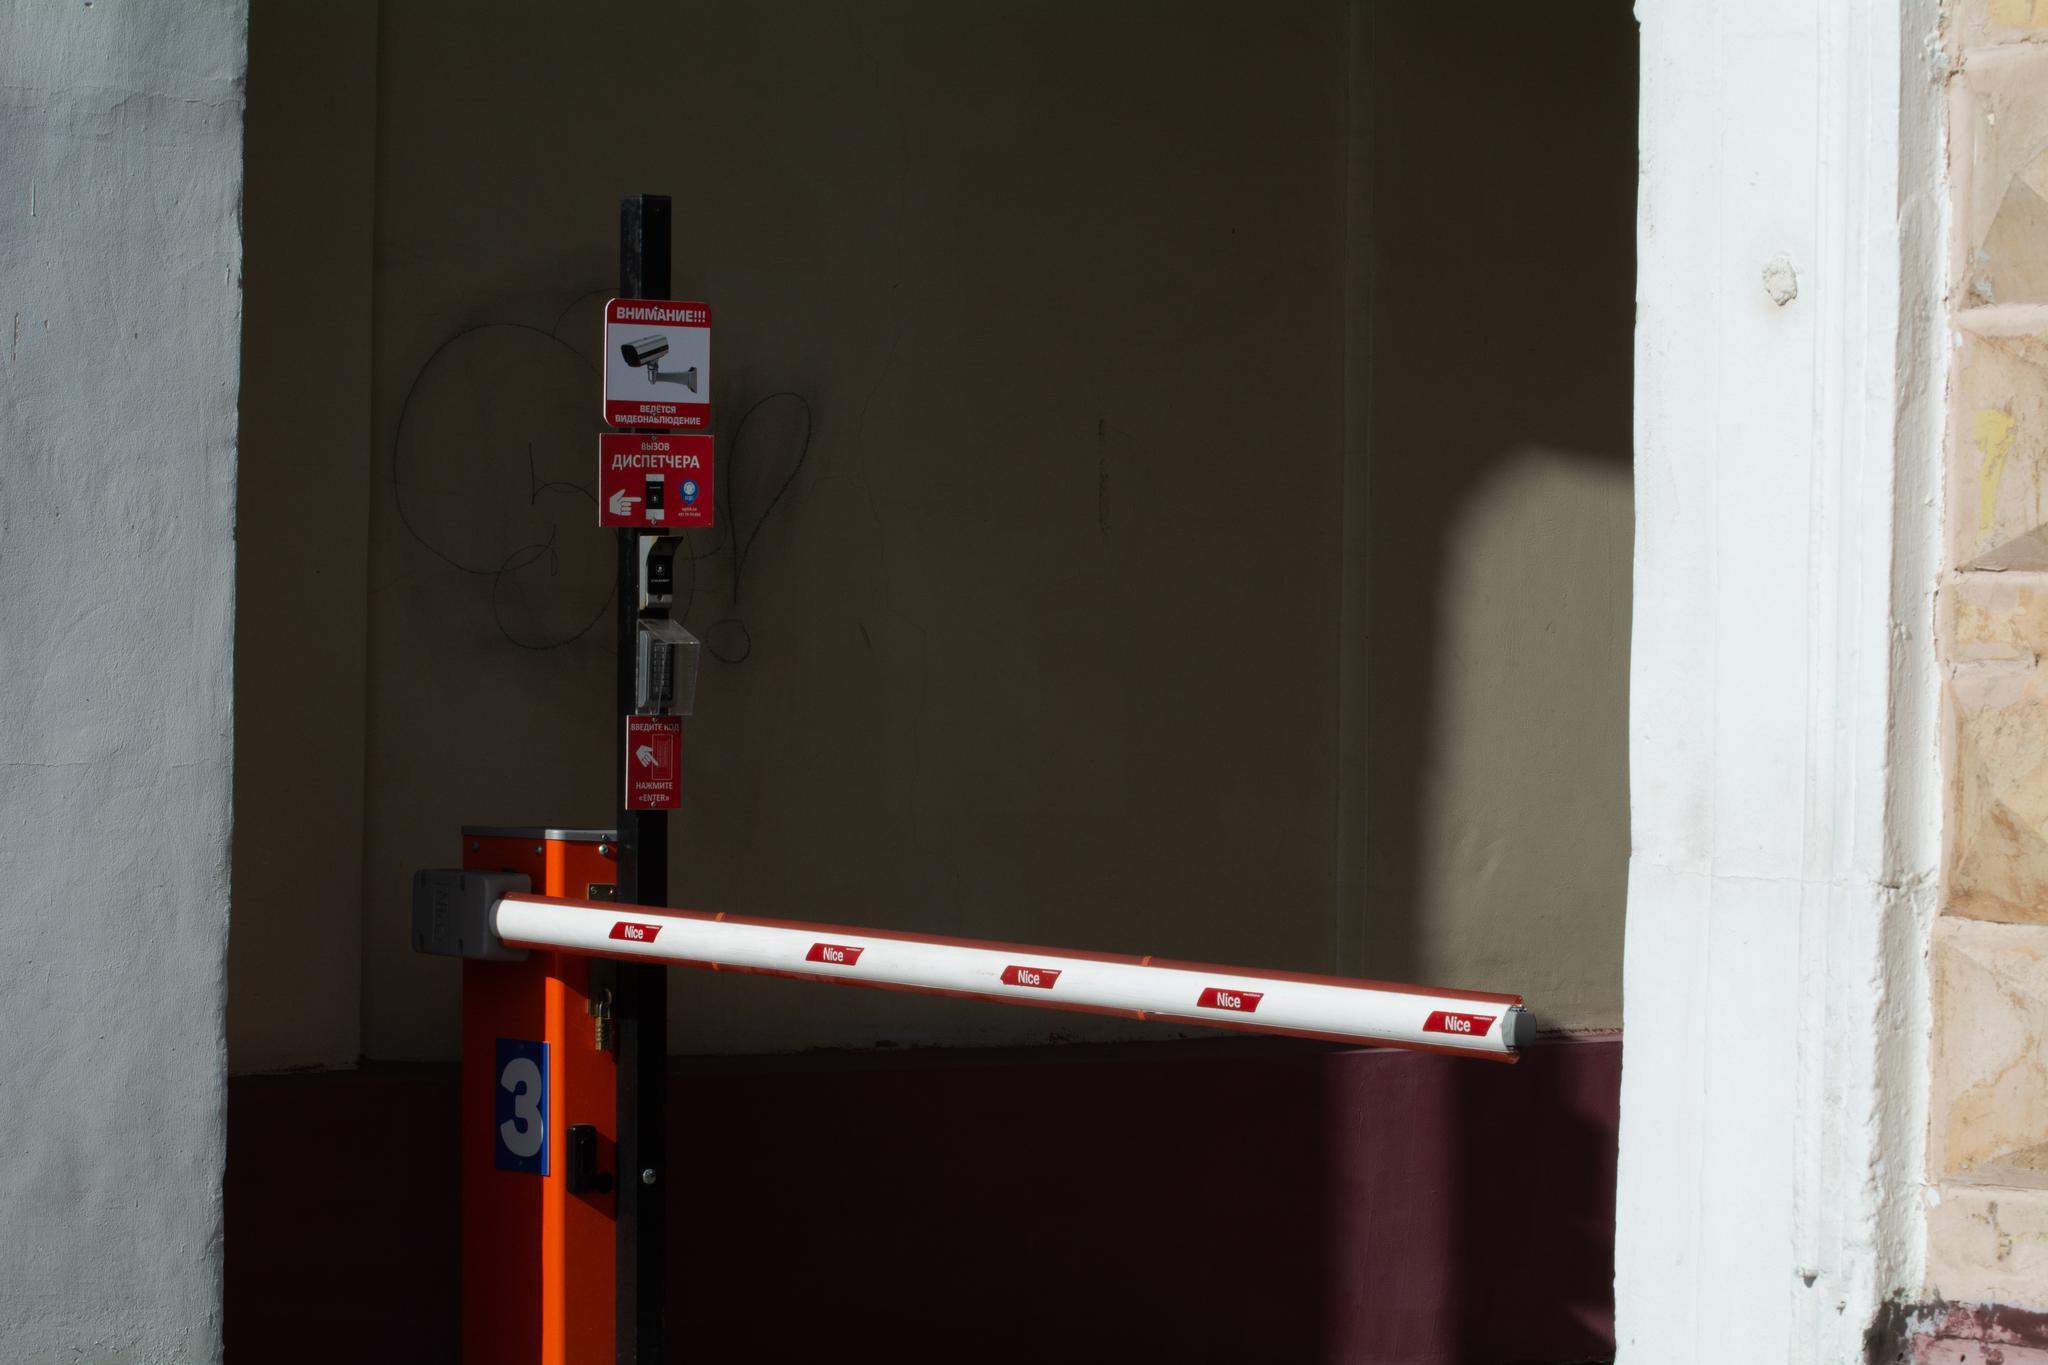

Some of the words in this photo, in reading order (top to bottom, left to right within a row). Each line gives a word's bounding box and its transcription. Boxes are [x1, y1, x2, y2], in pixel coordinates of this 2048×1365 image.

[616, 306, 706, 323] ВНИМАНИЕ!!!
[615, 414, 701, 425] ВИДЕОНАБЛЮДЕНИЕ
[641, 442, 670, 451] ВЫЗОВ
[611, 454, 700, 471] ДИСПЕТЧЕРА
[630, 723, 663, 732] ВВЕДИТЕ
[664, 723, 680, 732] КОД
[635, 781, 673, 790] НАЖМИТЕ
[624, 925, 644, 939] Nice
[822, 946, 844, 962] Nice
[1017, 969, 1040, 985] Nice
[1216, 991, 1241, 1008] Nice
[1444, 1015, 1471, 1032] Nice
[500, 1057, 544, 1158] 3
